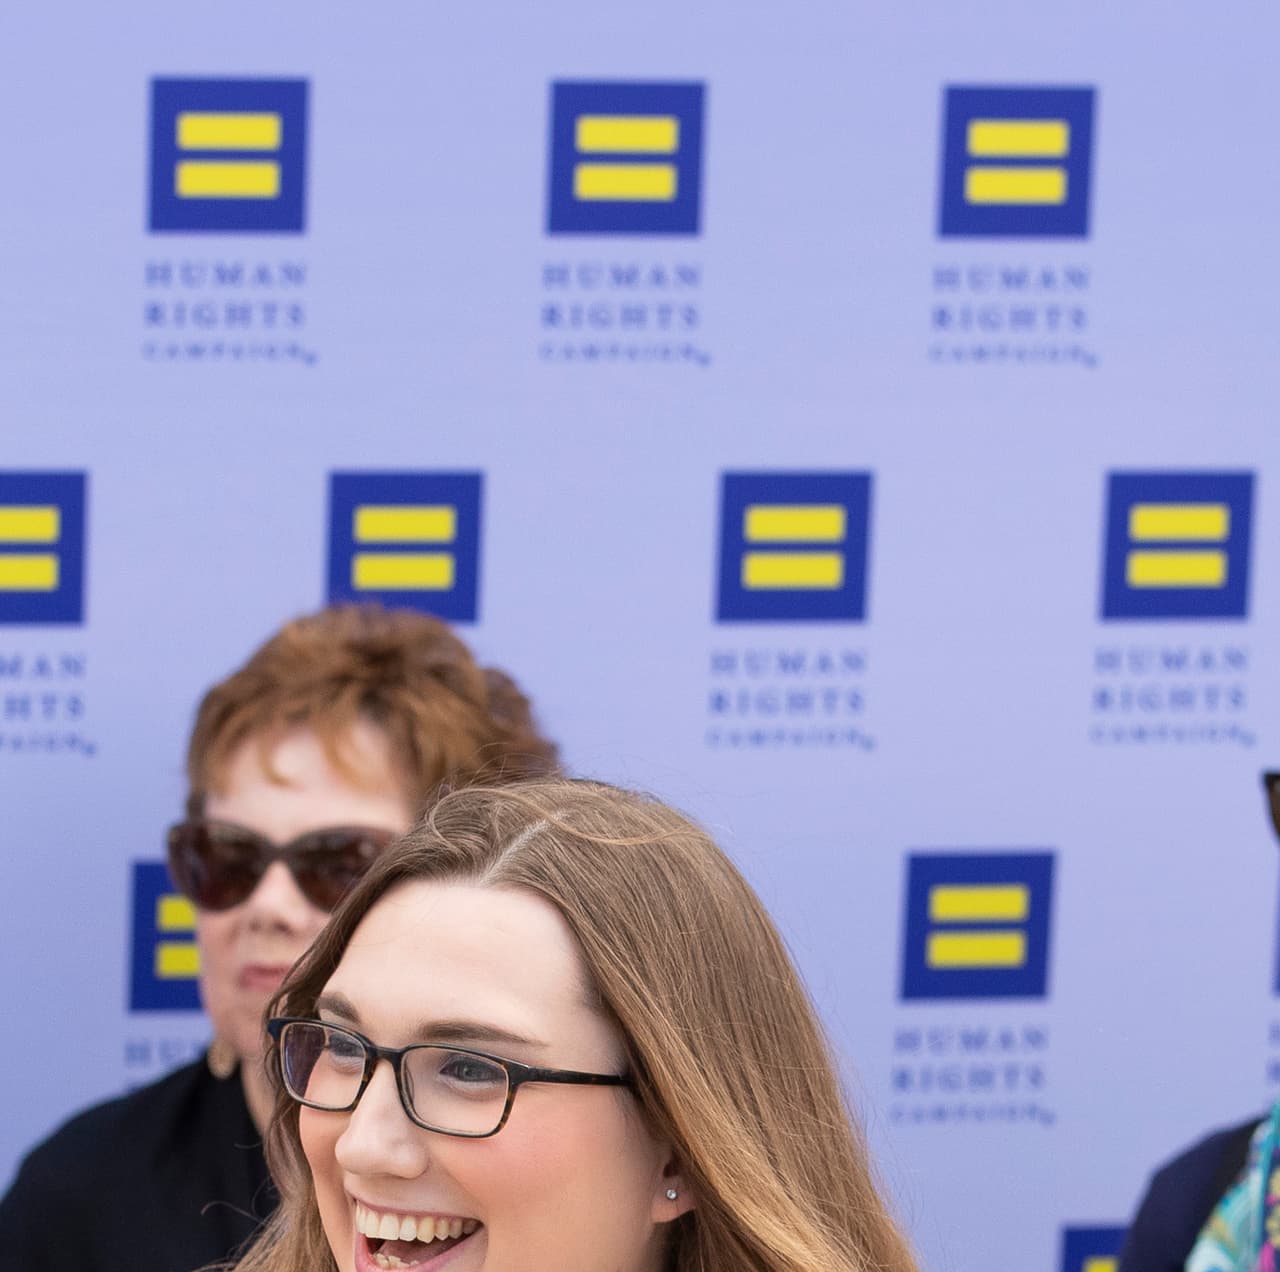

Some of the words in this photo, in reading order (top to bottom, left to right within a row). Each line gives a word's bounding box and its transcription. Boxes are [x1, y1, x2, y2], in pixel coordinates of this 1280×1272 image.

[143, 260, 308, 289] HUMAN
[540, 262, 702, 290] HUMAN
[931, 265, 1091, 292] HUMAN
[142, 300, 306, 329] RIGHTS
[539, 301, 700, 330] RIGHTS
[930, 304, 1088, 332] RIGHTS
[709, 650, 867, 676] HUMAN
[1093, 647, 1249, 673] HUMAN
[707, 687, 865, 716] RIGHTS
[1091, 685, 1247, 713] RIGHTS
[893, 1026, 1049, 1054] HUMAN
[890, 1063, 1046, 1093] RIGHTS
